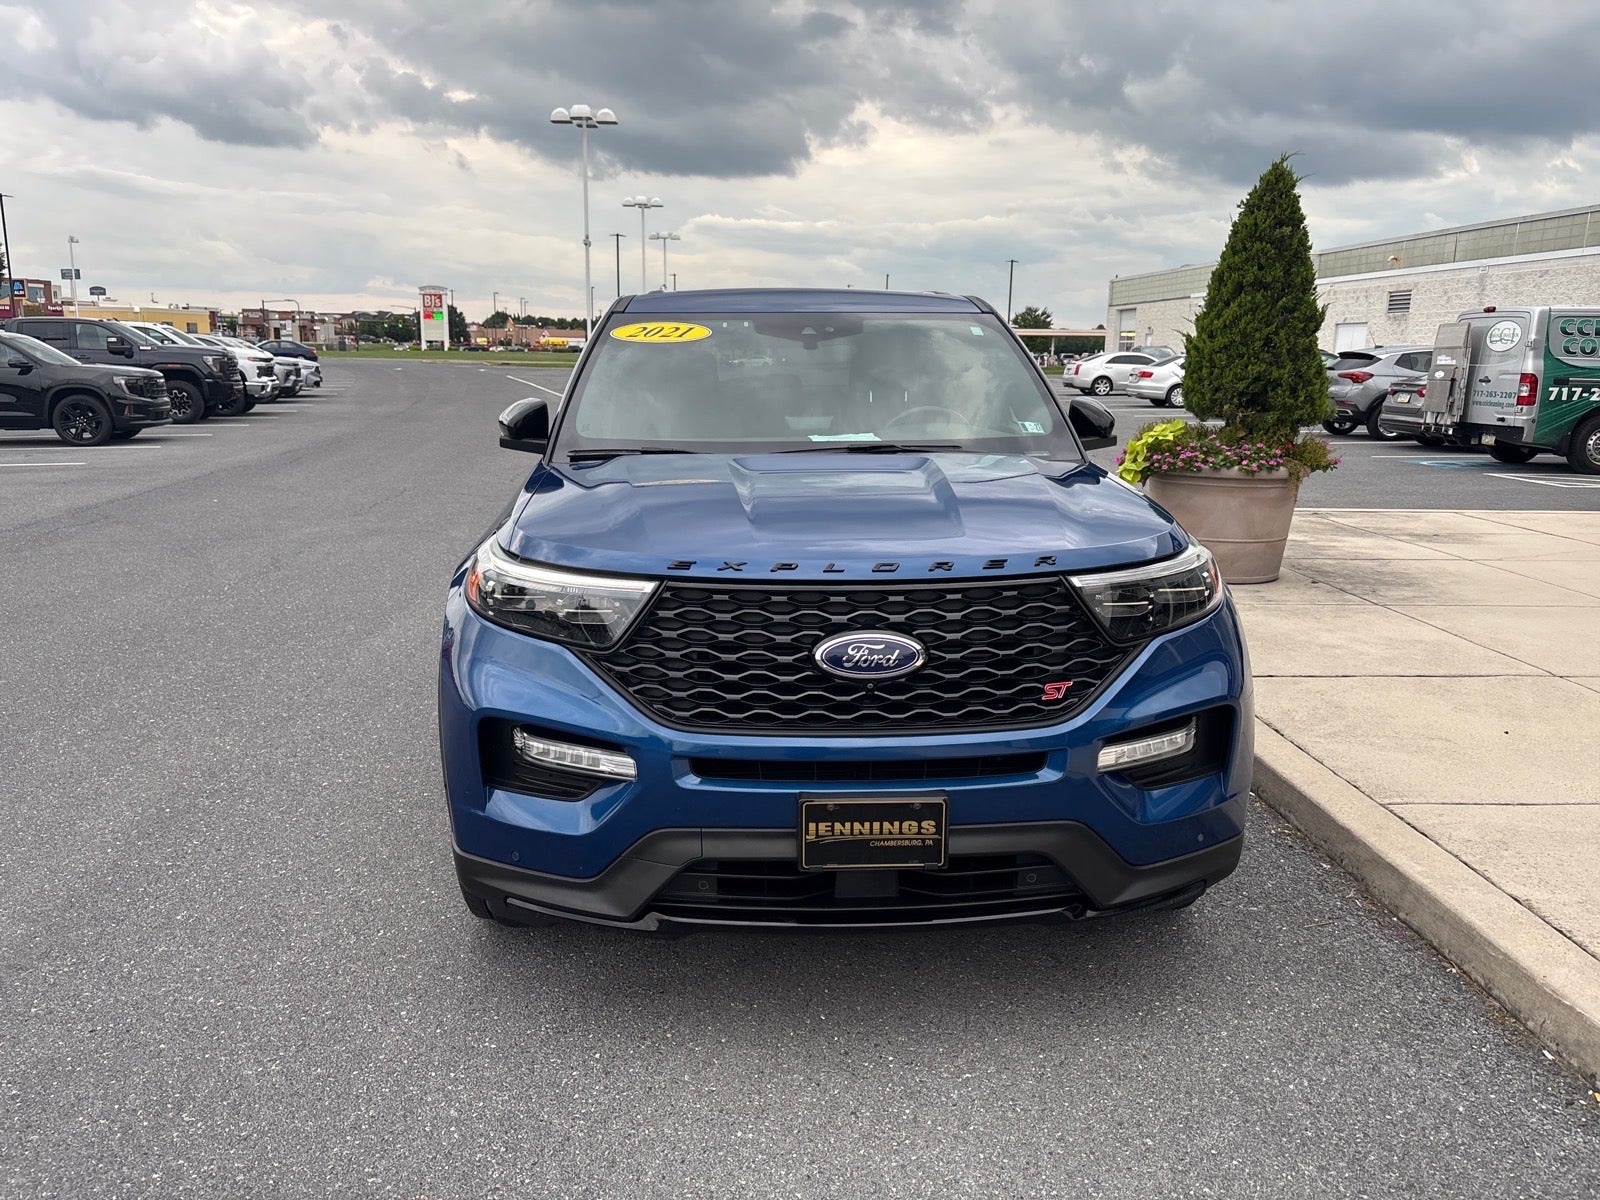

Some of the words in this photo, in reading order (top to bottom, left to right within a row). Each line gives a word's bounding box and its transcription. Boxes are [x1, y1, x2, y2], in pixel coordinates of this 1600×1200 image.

[424, 295, 441, 308] BJ's
[626, 327, 695, 338] 2021
[1562, 337, 1600, 356] CO
[1548, 387, 1600, 401] 717-2
[666, 555, 1057, 573] EXPLORER
[842, 643, 900, 668] Ford
[1042, 681, 1073, 701] ST
[806, 819, 936, 839] JENNINGS
[924, 839, 934, 847] PA
